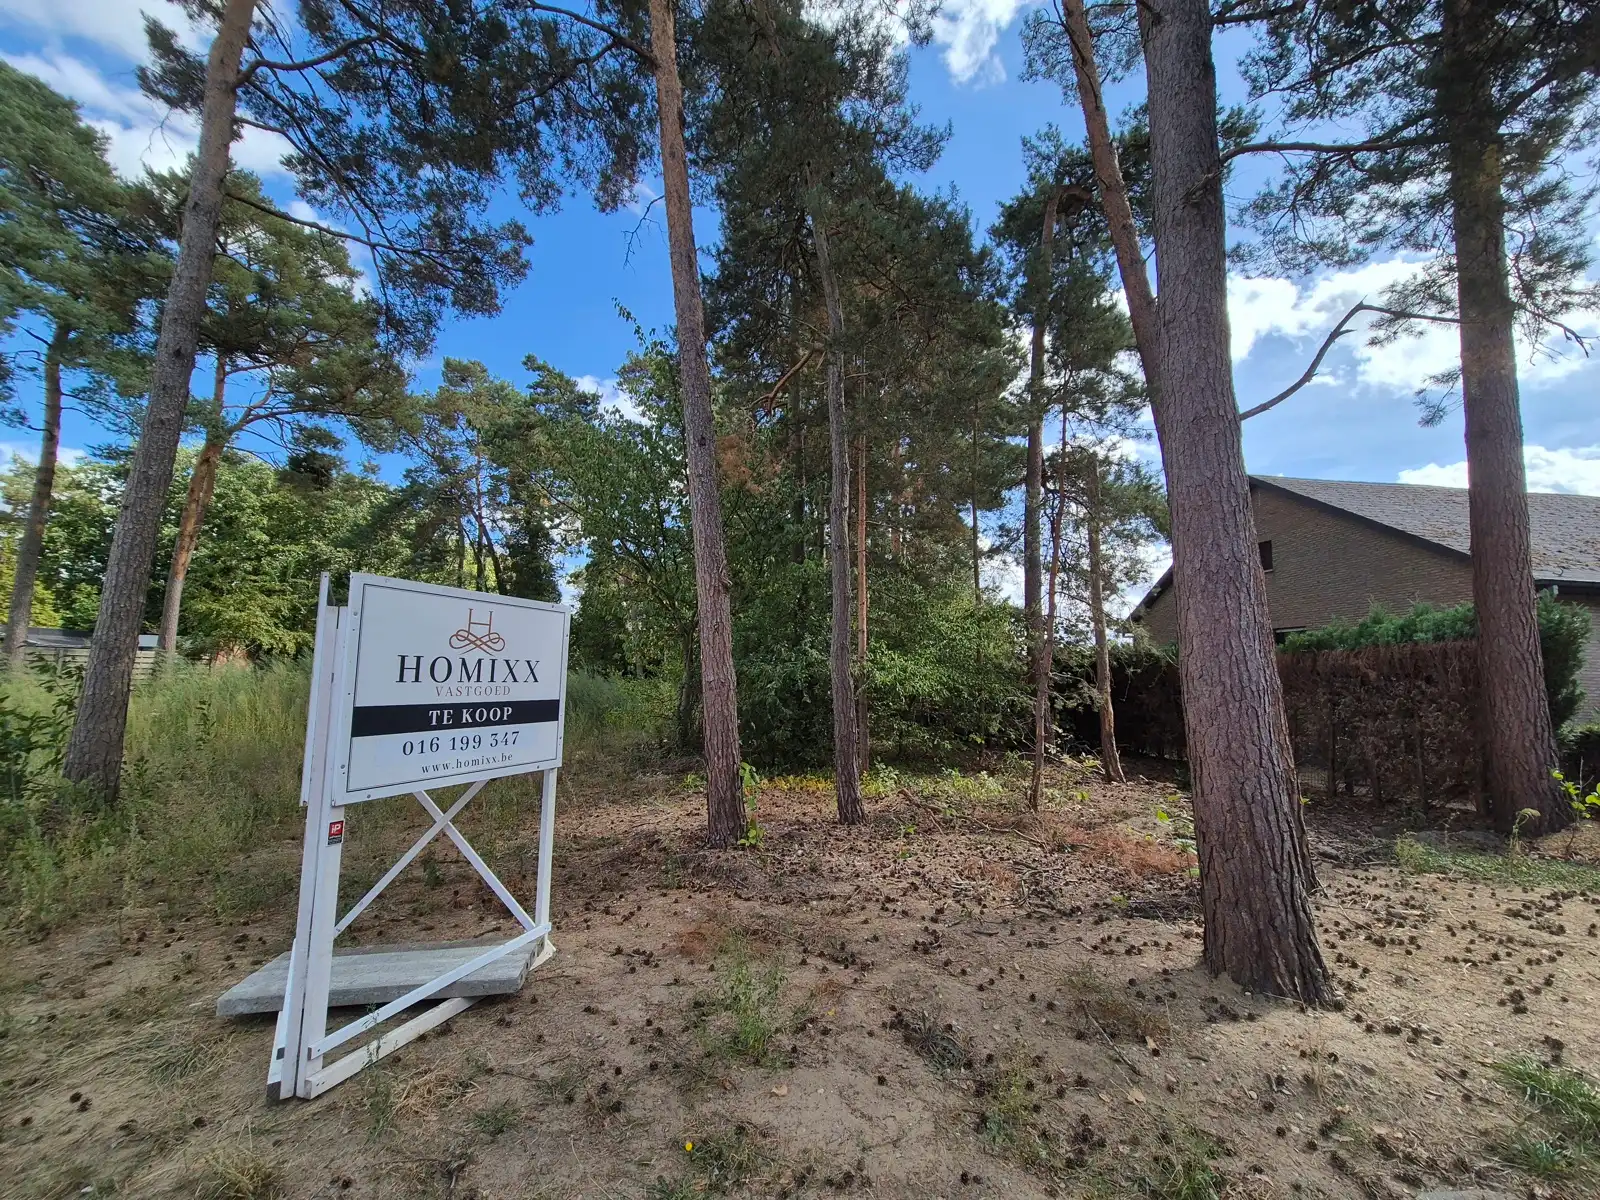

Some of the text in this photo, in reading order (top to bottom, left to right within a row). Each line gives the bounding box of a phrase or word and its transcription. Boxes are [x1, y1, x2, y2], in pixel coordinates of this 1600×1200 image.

[395, 654, 541, 684] HOMIXX
[435, 685, 511, 697] VASTGOED
[428, 706, 513, 726] TE KOOP
[402, 730, 520, 756] 016 199 347
[421, 752, 513, 774] www.homixx.be
